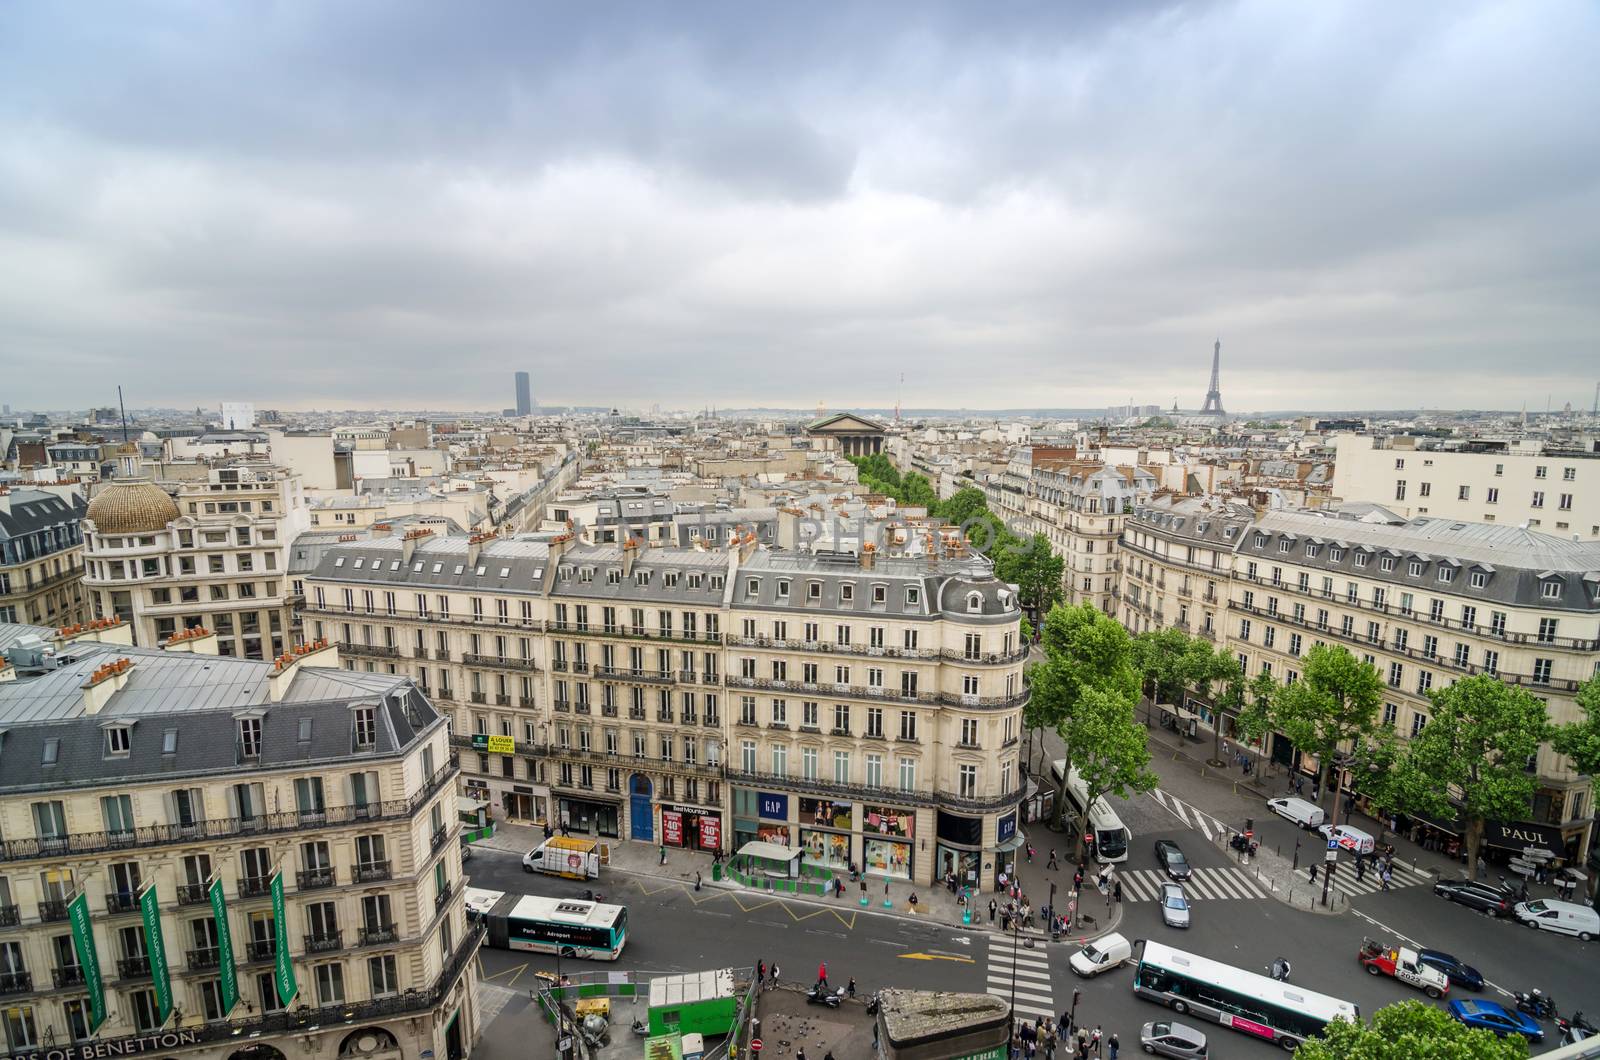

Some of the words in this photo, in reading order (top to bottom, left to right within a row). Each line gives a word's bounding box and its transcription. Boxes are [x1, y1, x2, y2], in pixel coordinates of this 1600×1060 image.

[673, 804, 683, 812] Best
[684, 806, 709, 816] Mountain
[765, 800, 781, 813] GAP
[1501, 826, 1548, 844] PAUL
[522, 927, 536, 935] Paris
[214, 887, 223, 918] UNITED
[220, 918, 229, 949] COLORS
[226, 960, 235, 1001] BENETTON
[146, 895, 156, 926] UNITED
[151, 926, 160, 957] COLORS
[160, 968, 169, 1009] BENETTON
[75, 904, 87, 935] UNITED
[83, 934, 94, 965] COLORS
[92, 977, 102, 1019] BENETTON
[280, 952, 291, 993] BENETTON
[1401, 971, 1420, 983] 2022
[47, 1048, 75, 1060] OF
